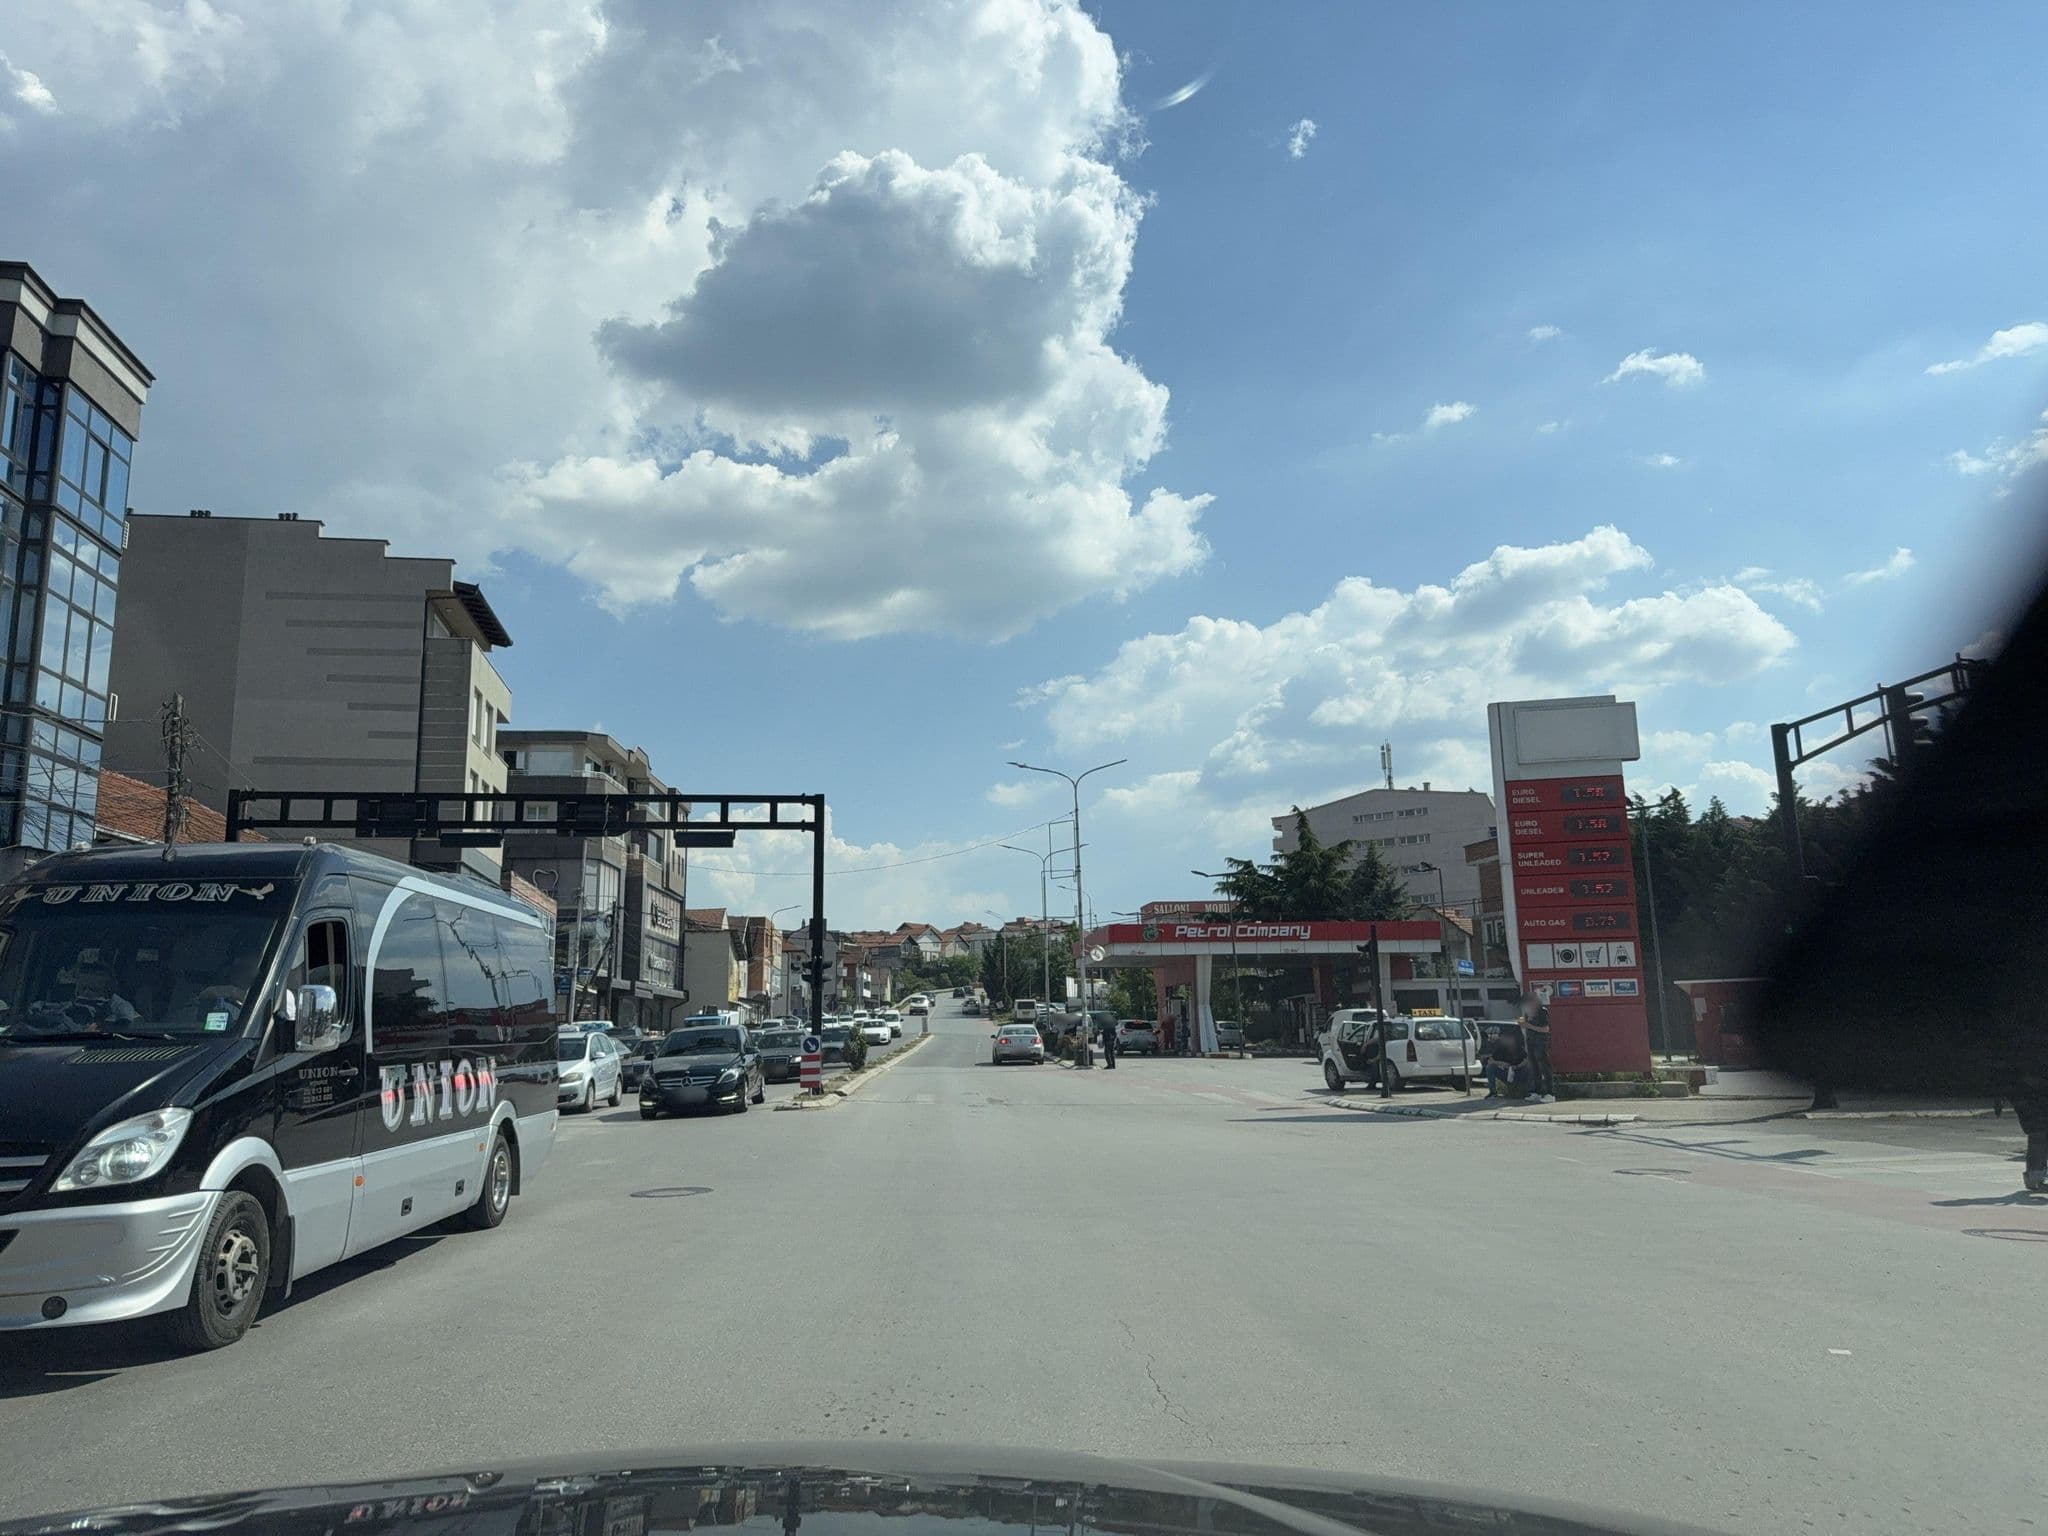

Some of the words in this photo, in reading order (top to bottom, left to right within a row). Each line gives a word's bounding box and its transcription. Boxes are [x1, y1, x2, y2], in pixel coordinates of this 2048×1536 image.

[1514, 820, 1538, 828] EURO
[1518, 851, 1544, 859] SUPER
[1518, 859, 1561, 867] UNLEADED
[43, 883, 239, 905] UNION
[1154, 903, 1190, 914] SALLONI
[1175, 925, 1231, 938] Petrol
[1235, 924, 1312, 940] Company
[298, 1066, 339, 1079] UNION
[379, 1056, 497, 1132] UNION
